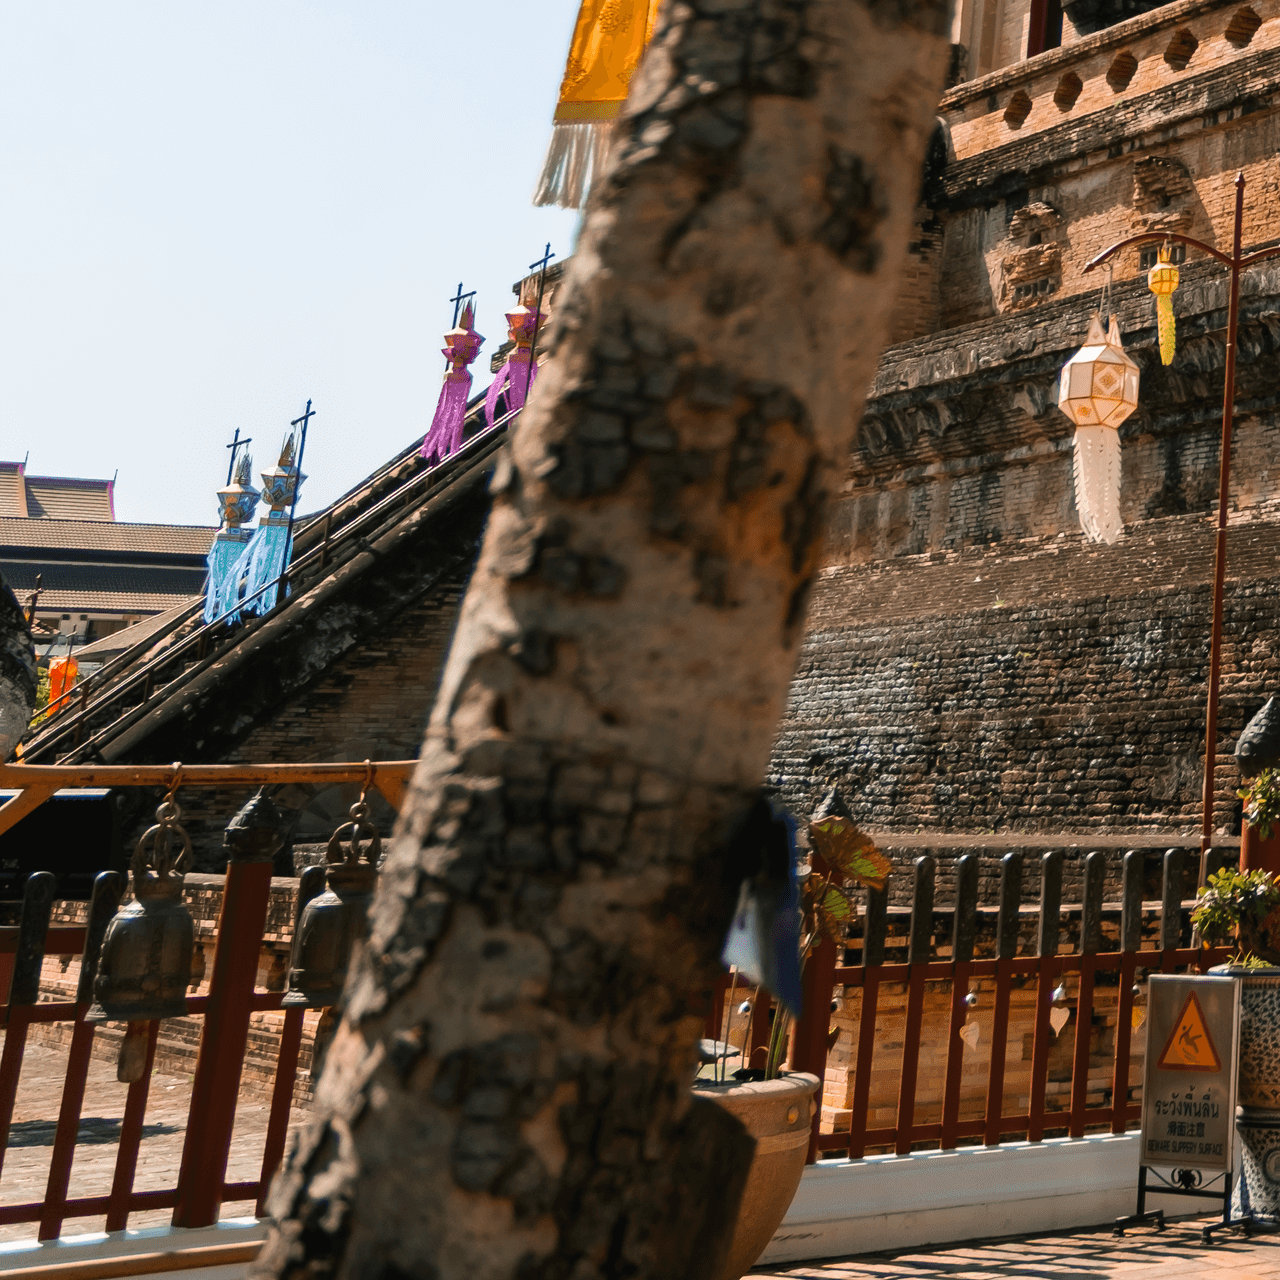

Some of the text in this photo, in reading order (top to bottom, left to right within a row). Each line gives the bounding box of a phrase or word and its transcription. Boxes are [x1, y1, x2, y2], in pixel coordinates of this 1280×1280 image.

[1155, 1085, 1220, 1118] ระวังพื้นลื่น
[1147, 1139, 1223, 1156] BEWARE SLIPPERY SURFACE
